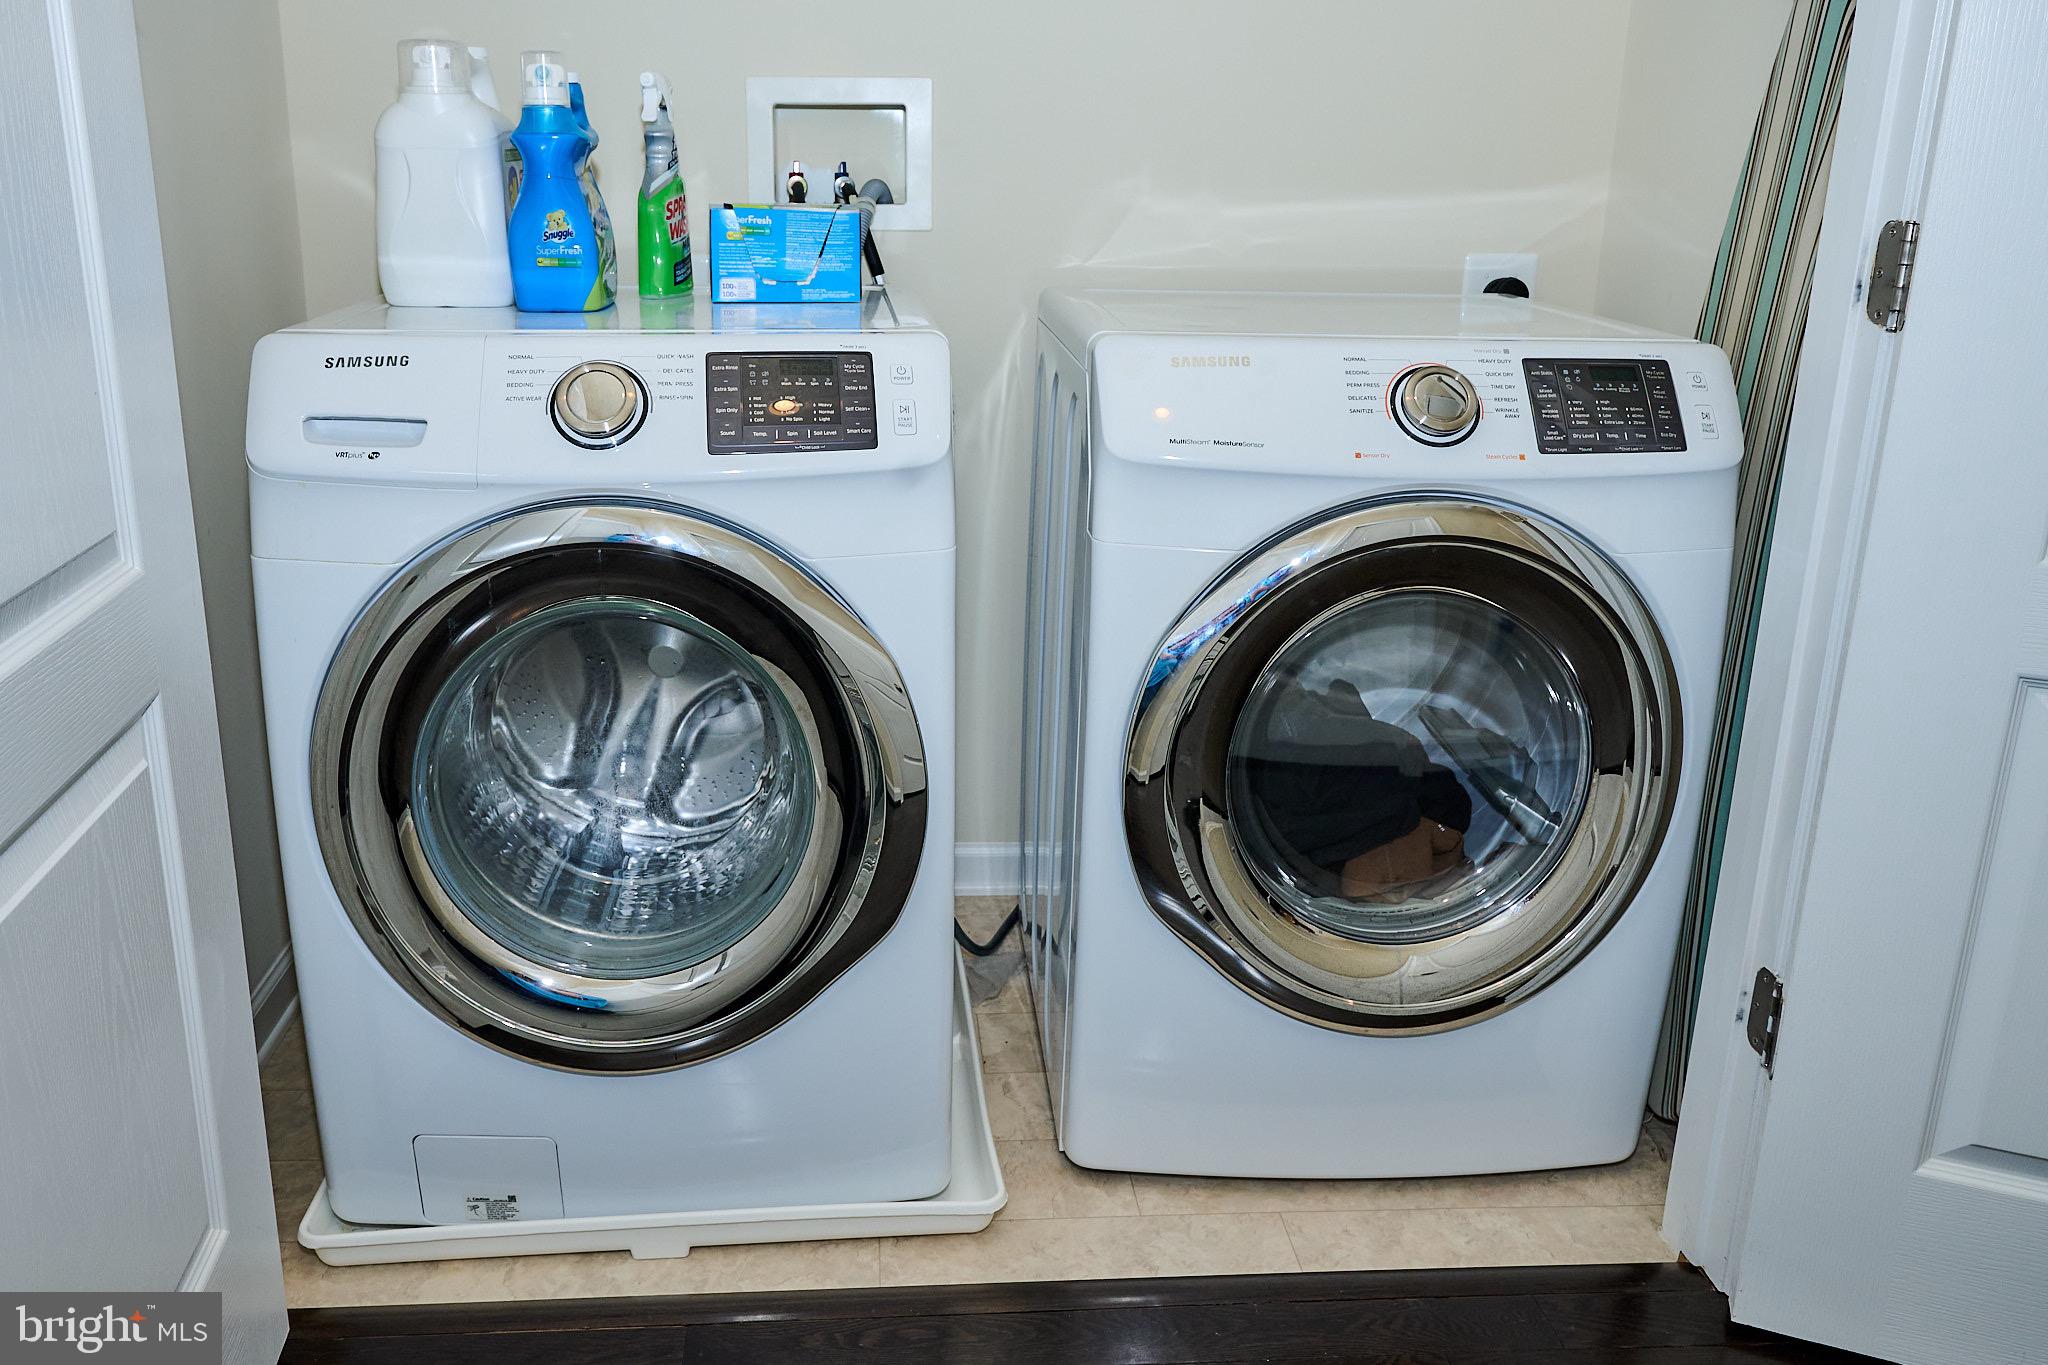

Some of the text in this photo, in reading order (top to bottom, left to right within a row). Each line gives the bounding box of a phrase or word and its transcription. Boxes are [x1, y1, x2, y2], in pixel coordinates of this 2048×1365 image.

[543, 228, 574, 242] Snuggle
[536, 244, 583, 256] SuperFresh
[324, 355, 410, 369] SAMSUNG
[1170, 355, 1251, 368] SAMSUNG
